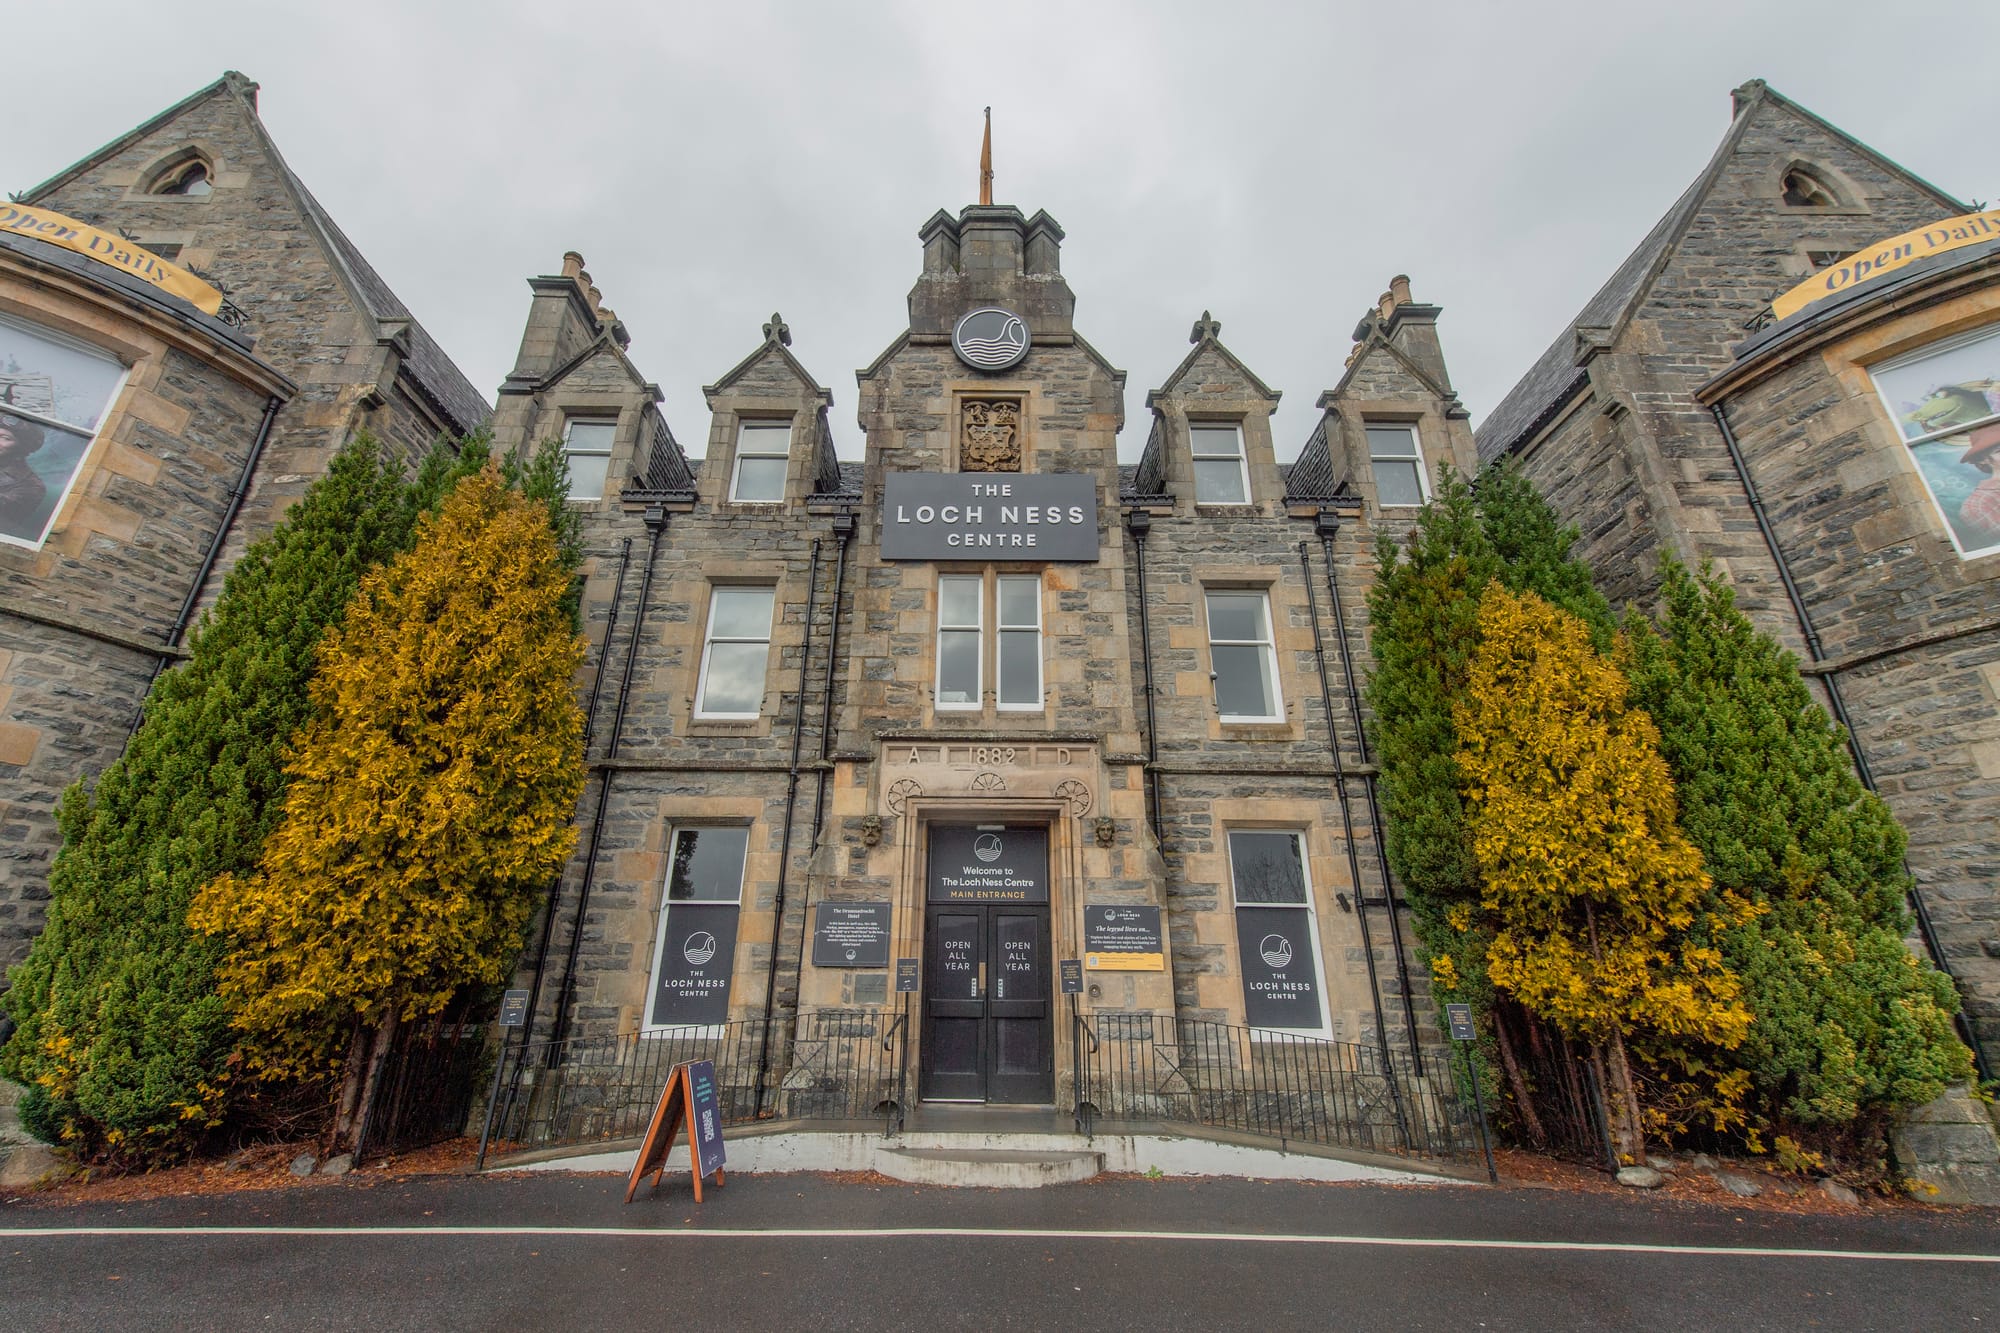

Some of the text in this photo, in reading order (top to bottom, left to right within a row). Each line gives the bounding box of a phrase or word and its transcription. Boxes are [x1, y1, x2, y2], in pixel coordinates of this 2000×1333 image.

[0, 206, 172, 282] Open Daily
[1825, 243, 1913, 291] Open
[971, 484, 1012, 496] THE
[897, 505, 1084, 524] LOCH NESS
[947, 533, 1036, 547] CENTRE
[908, 746, 1072, 765] A 1882 D
[963, 866, 1014, 875] Welcome to
[942, 877, 1034, 887] The Loch Ness Centre
[977, 891, 1025, 899] ENTRANCE
[1107, 925, 1124, 933] legend
[945, 941, 971, 949] OPEN
[1008, 952, 1027, 960] ALL
[945, 962, 970, 970] YEAR
[1005, 963, 1031, 971] YEAR
[665, 980, 725, 988] LOCH NESS
[1250, 982, 1311, 991] LOCH NESS
